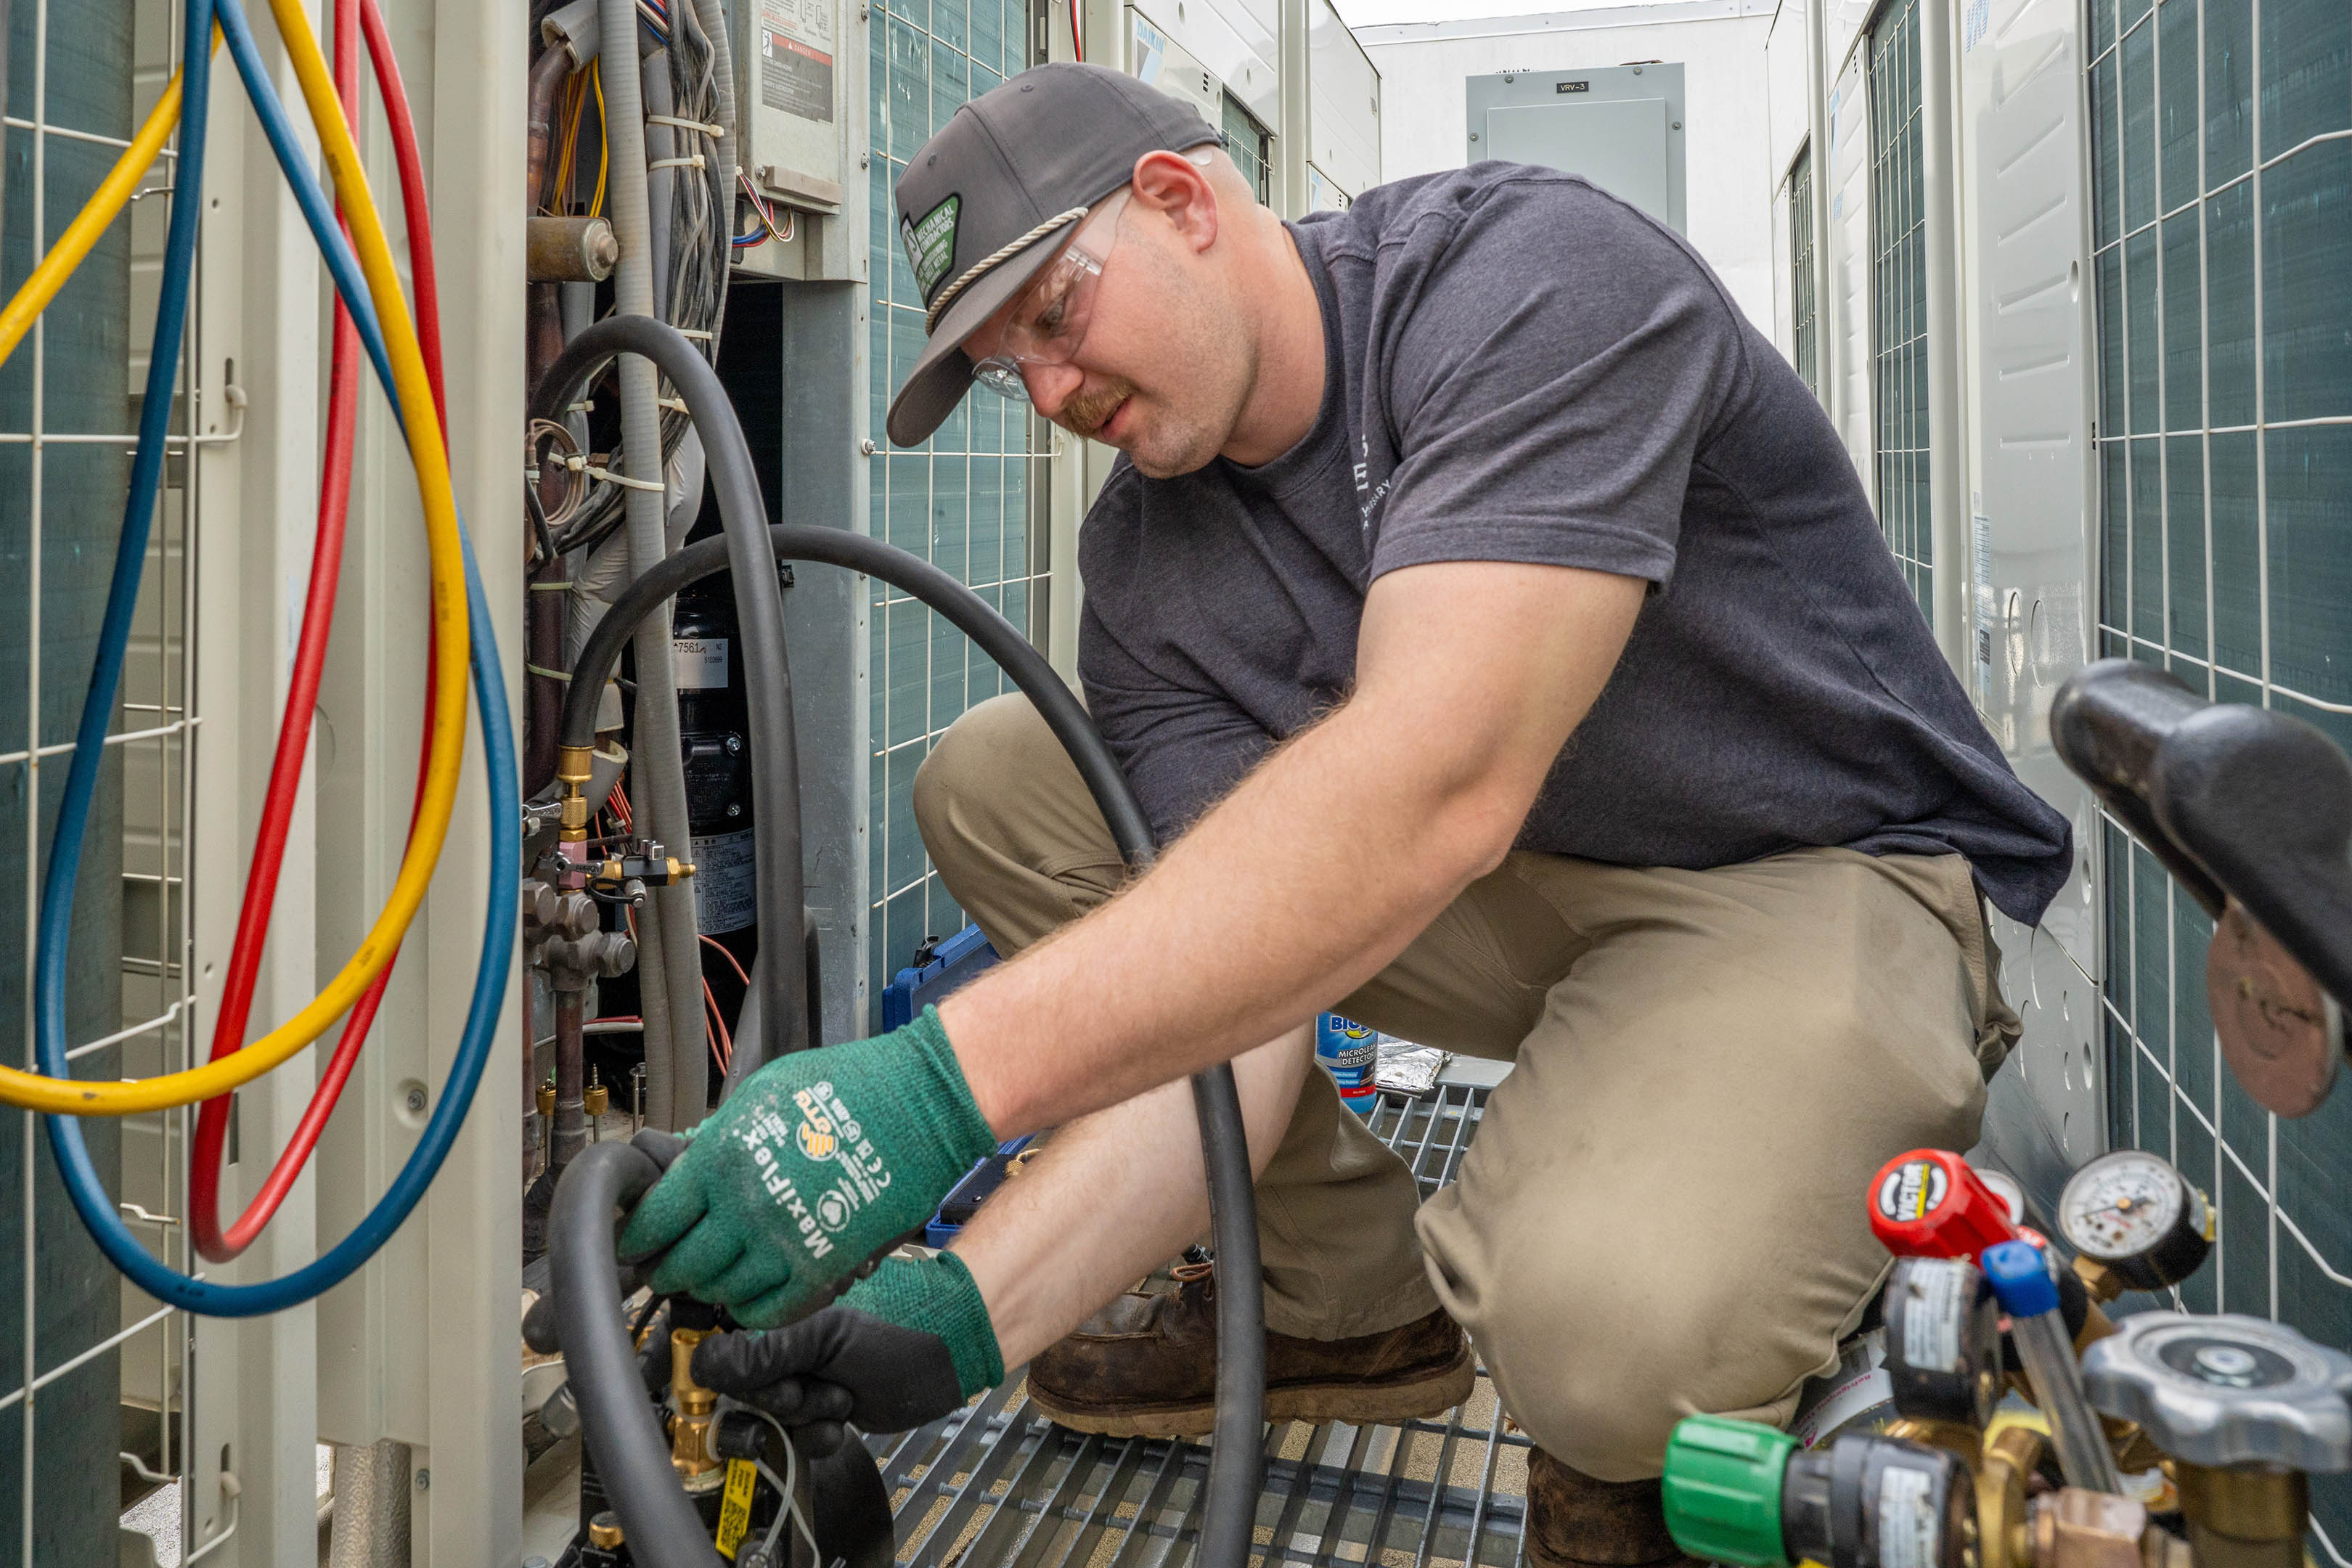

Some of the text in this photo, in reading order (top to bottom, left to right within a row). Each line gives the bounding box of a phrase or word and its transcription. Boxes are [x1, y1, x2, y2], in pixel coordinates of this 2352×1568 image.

[1137, 20, 1166, 54] DAIKIN
[916, 205, 955, 242] MECHANICAL
[920, 217, 955, 253] CONTRACTORS
[742, 1127, 835, 1260] MaxiFlex
